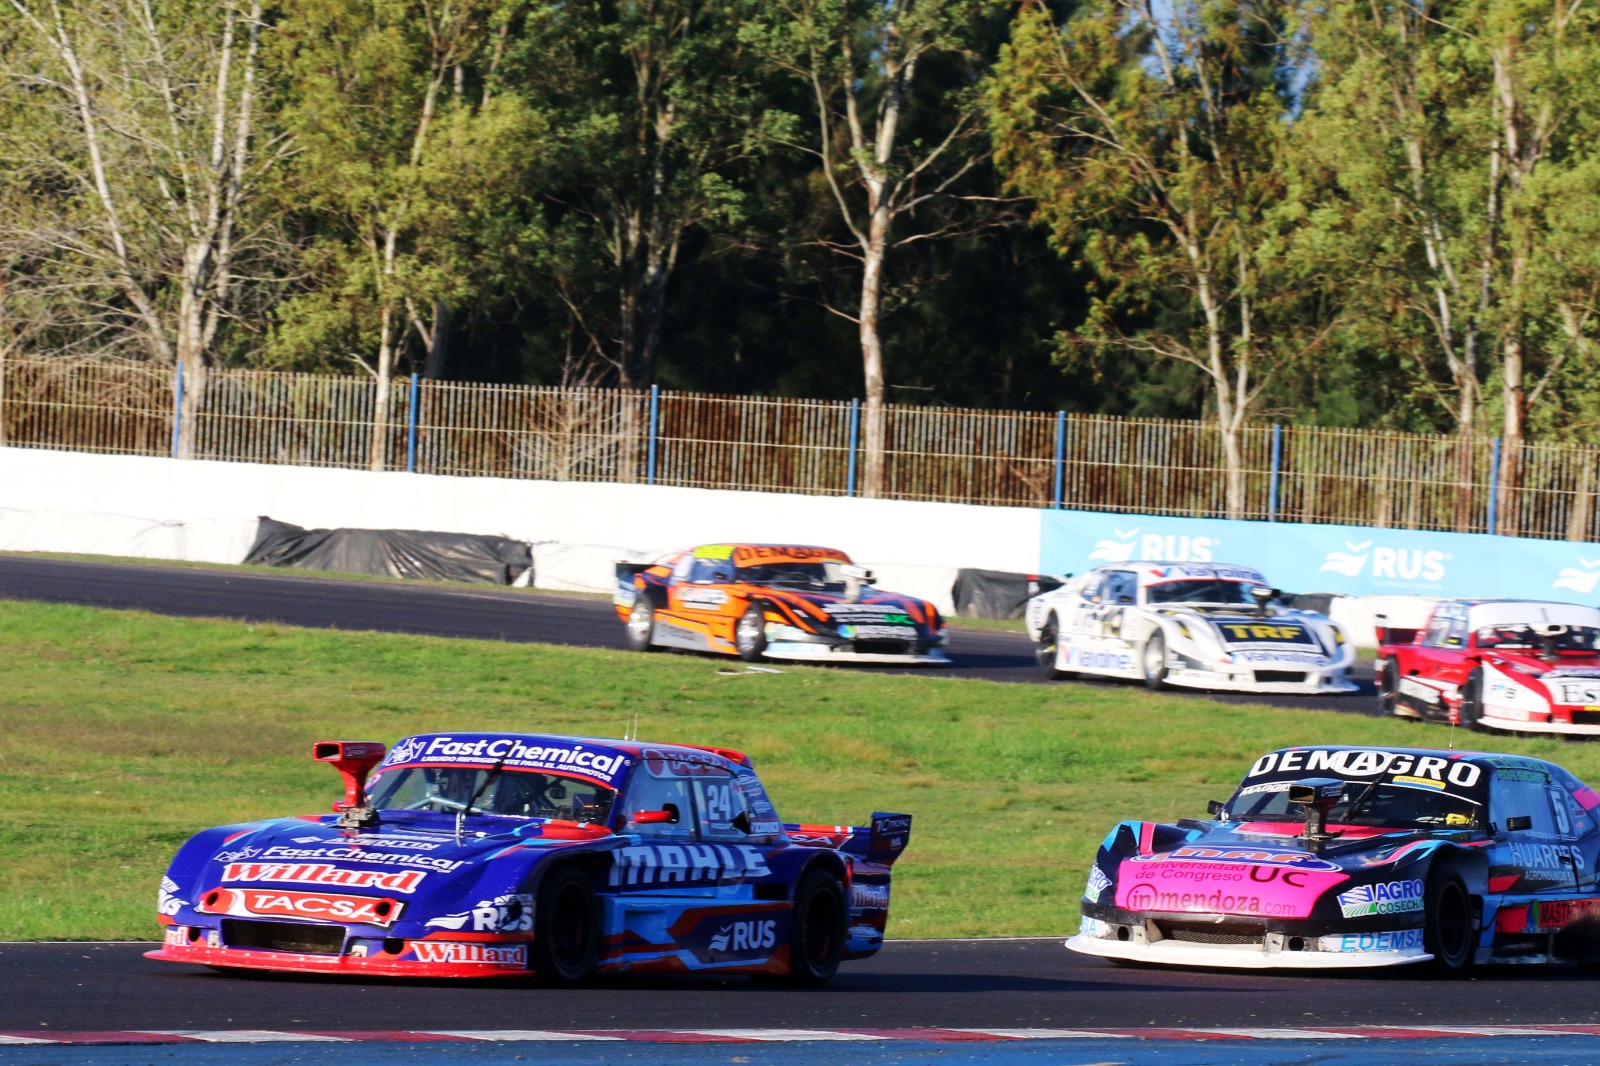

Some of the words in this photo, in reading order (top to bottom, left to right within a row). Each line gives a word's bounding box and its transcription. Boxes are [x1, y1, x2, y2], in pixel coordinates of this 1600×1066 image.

[1141, 534, 1213, 562] RUS
[1372, 547, 1446, 582] RUS
[1222, 624, 1302, 640] TRF
[457, 756, 519, 767] REFRIGERNTE
[1248, 749, 1482, 788] DEMAGRO
[707, 784, 731, 821] 24
[1550, 790, 1569, 834] 5
[222, 863, 426, 894] Willard
[608, 844, 772, 886] MAHLE
[1135, 870, 1155, 880] de
[1160, 869, 1243, 882] Congreso
[1250, 864, 1310, 888] UC
[1377, 879, 1424, 901] AGRO
[733, 919, 777, 951] RUS
[411, 941, 527, 964] Willard
